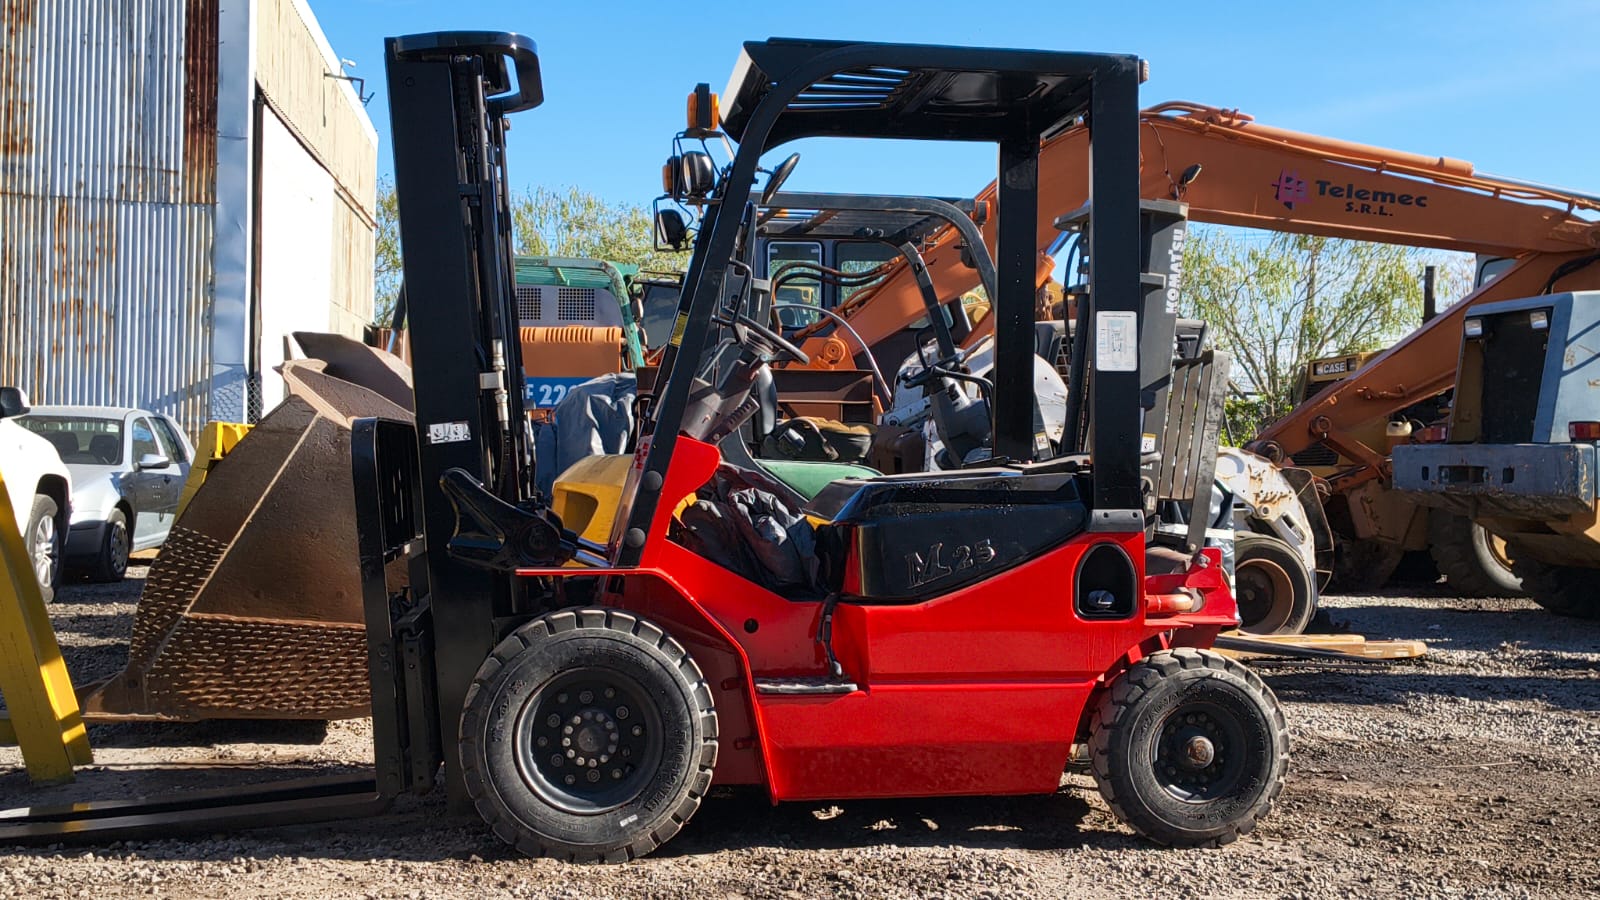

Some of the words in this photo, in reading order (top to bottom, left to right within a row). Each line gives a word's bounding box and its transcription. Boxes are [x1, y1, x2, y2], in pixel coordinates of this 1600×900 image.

[1315, 180, 1428, 207] Telemec
[1345, 202, 1393, 217] S.R.L.
[1166, 229, 1184, 314] KOMATSU
[1323, 362, 1345, 374] CASE
